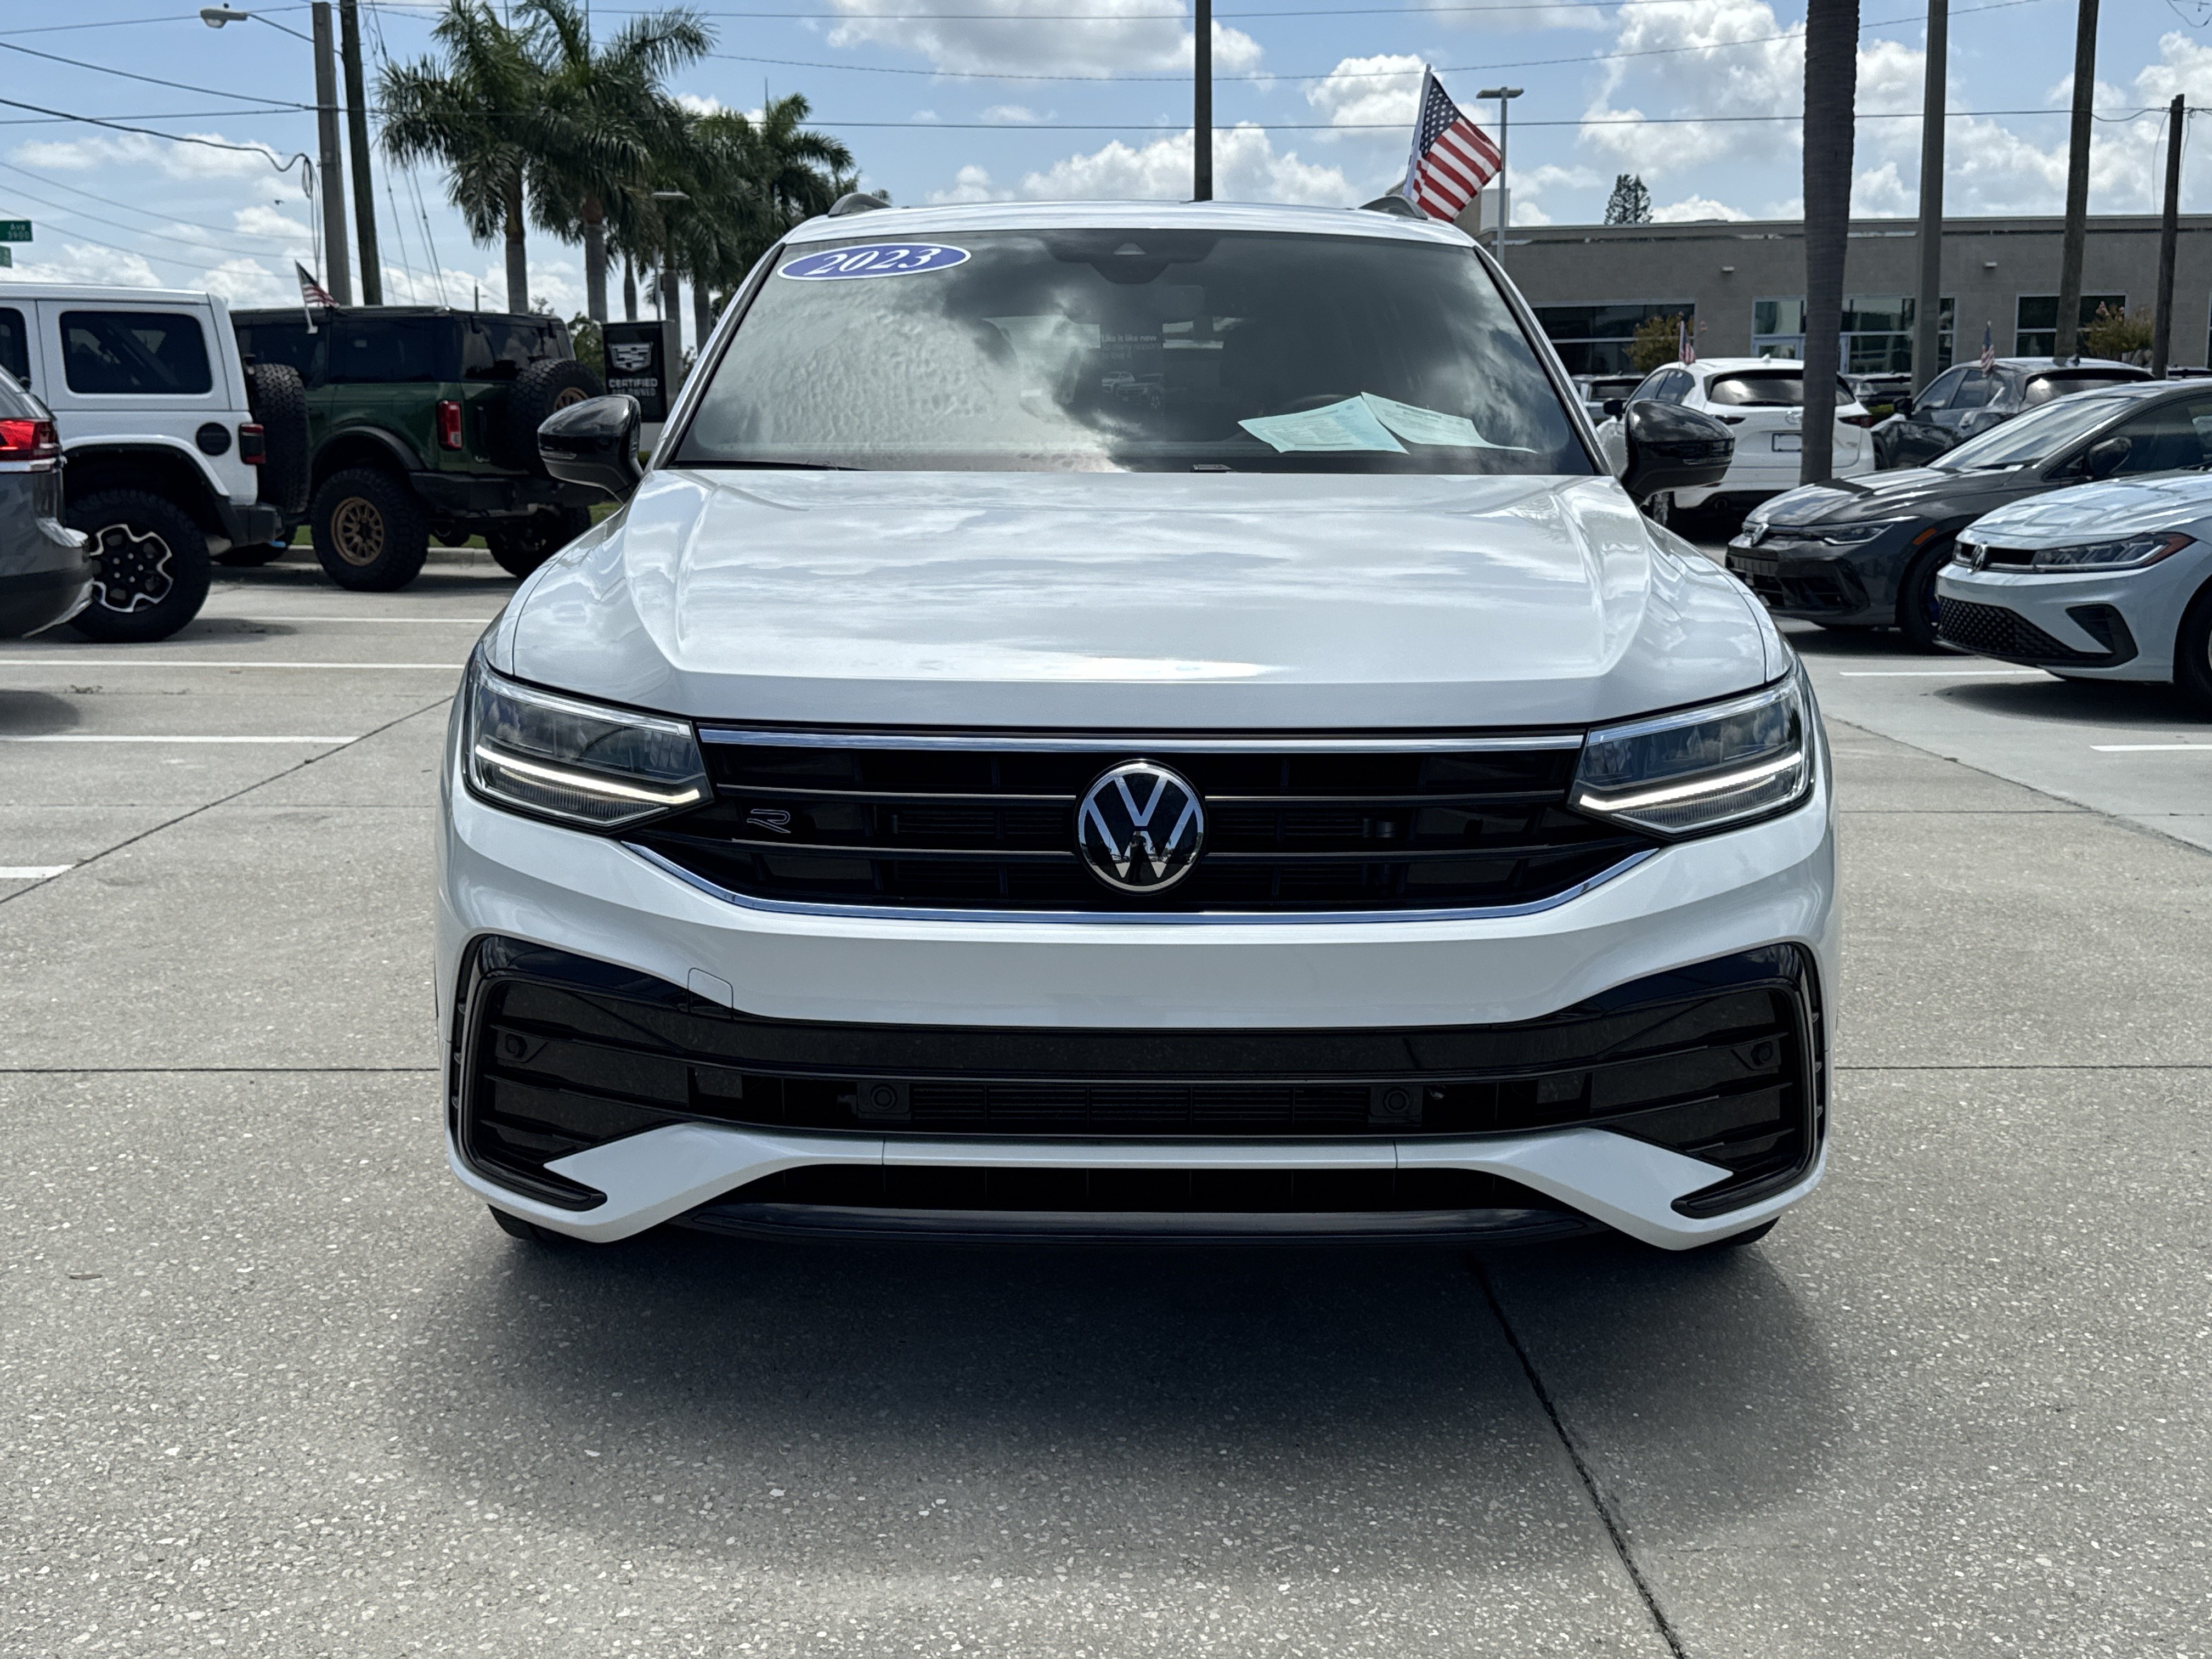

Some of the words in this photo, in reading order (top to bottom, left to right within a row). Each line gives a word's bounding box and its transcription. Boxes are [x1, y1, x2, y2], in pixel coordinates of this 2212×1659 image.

[803, 248, 941, 276] 2023
[608, 377, 658, 388] CERTIFIED
[747, 809, 791, 833] R
[1082, 768, 1200, 882] VW
